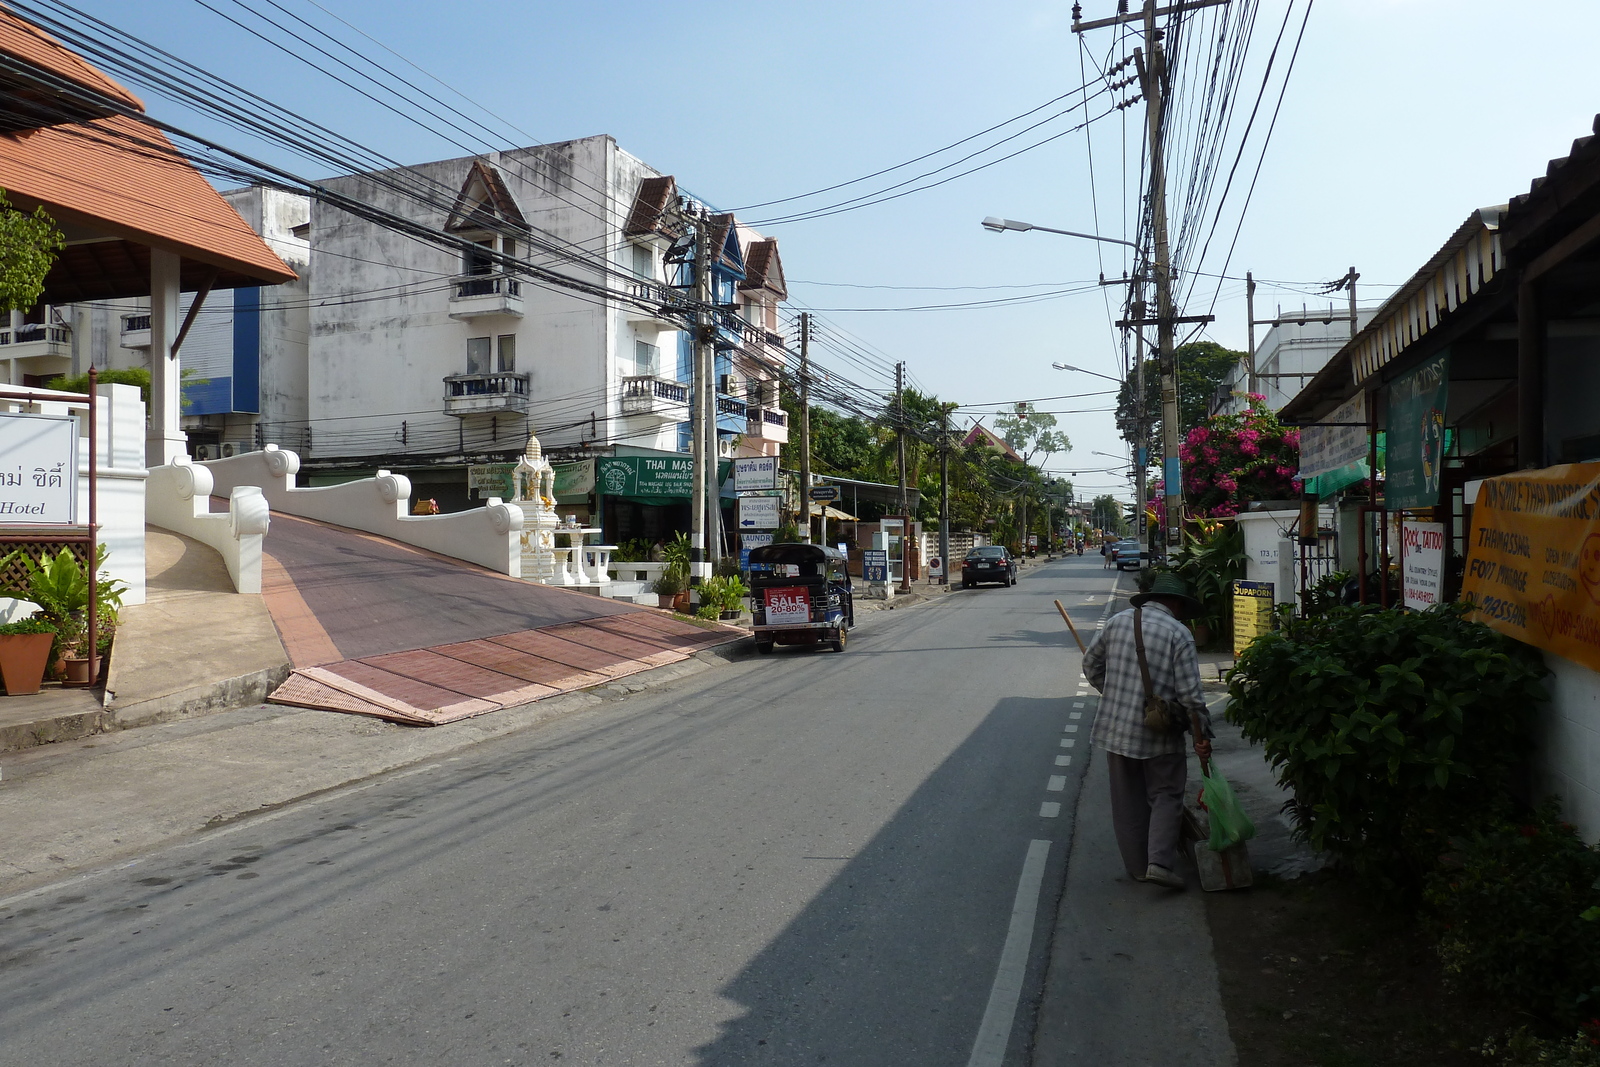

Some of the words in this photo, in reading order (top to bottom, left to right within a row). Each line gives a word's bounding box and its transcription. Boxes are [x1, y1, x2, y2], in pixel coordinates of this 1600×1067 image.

[645, 460, 666, 470] THAI
[32, 462, 66, 488] ซิตี้
[1524, 481, 1546, 514] THAI
[0, 501, 46, 515] Hotel
[741, 534, 775, 542] LAUNDRY
[1422, 530, 1443, 550] TATTOO
[1233, 583, 1272, 597] SUPAPORN
[770, 595, 805, 607] SALE
[771, 604, 805, 614] 20-80%
[1481, 595, 1527, 629] MASSAGE
